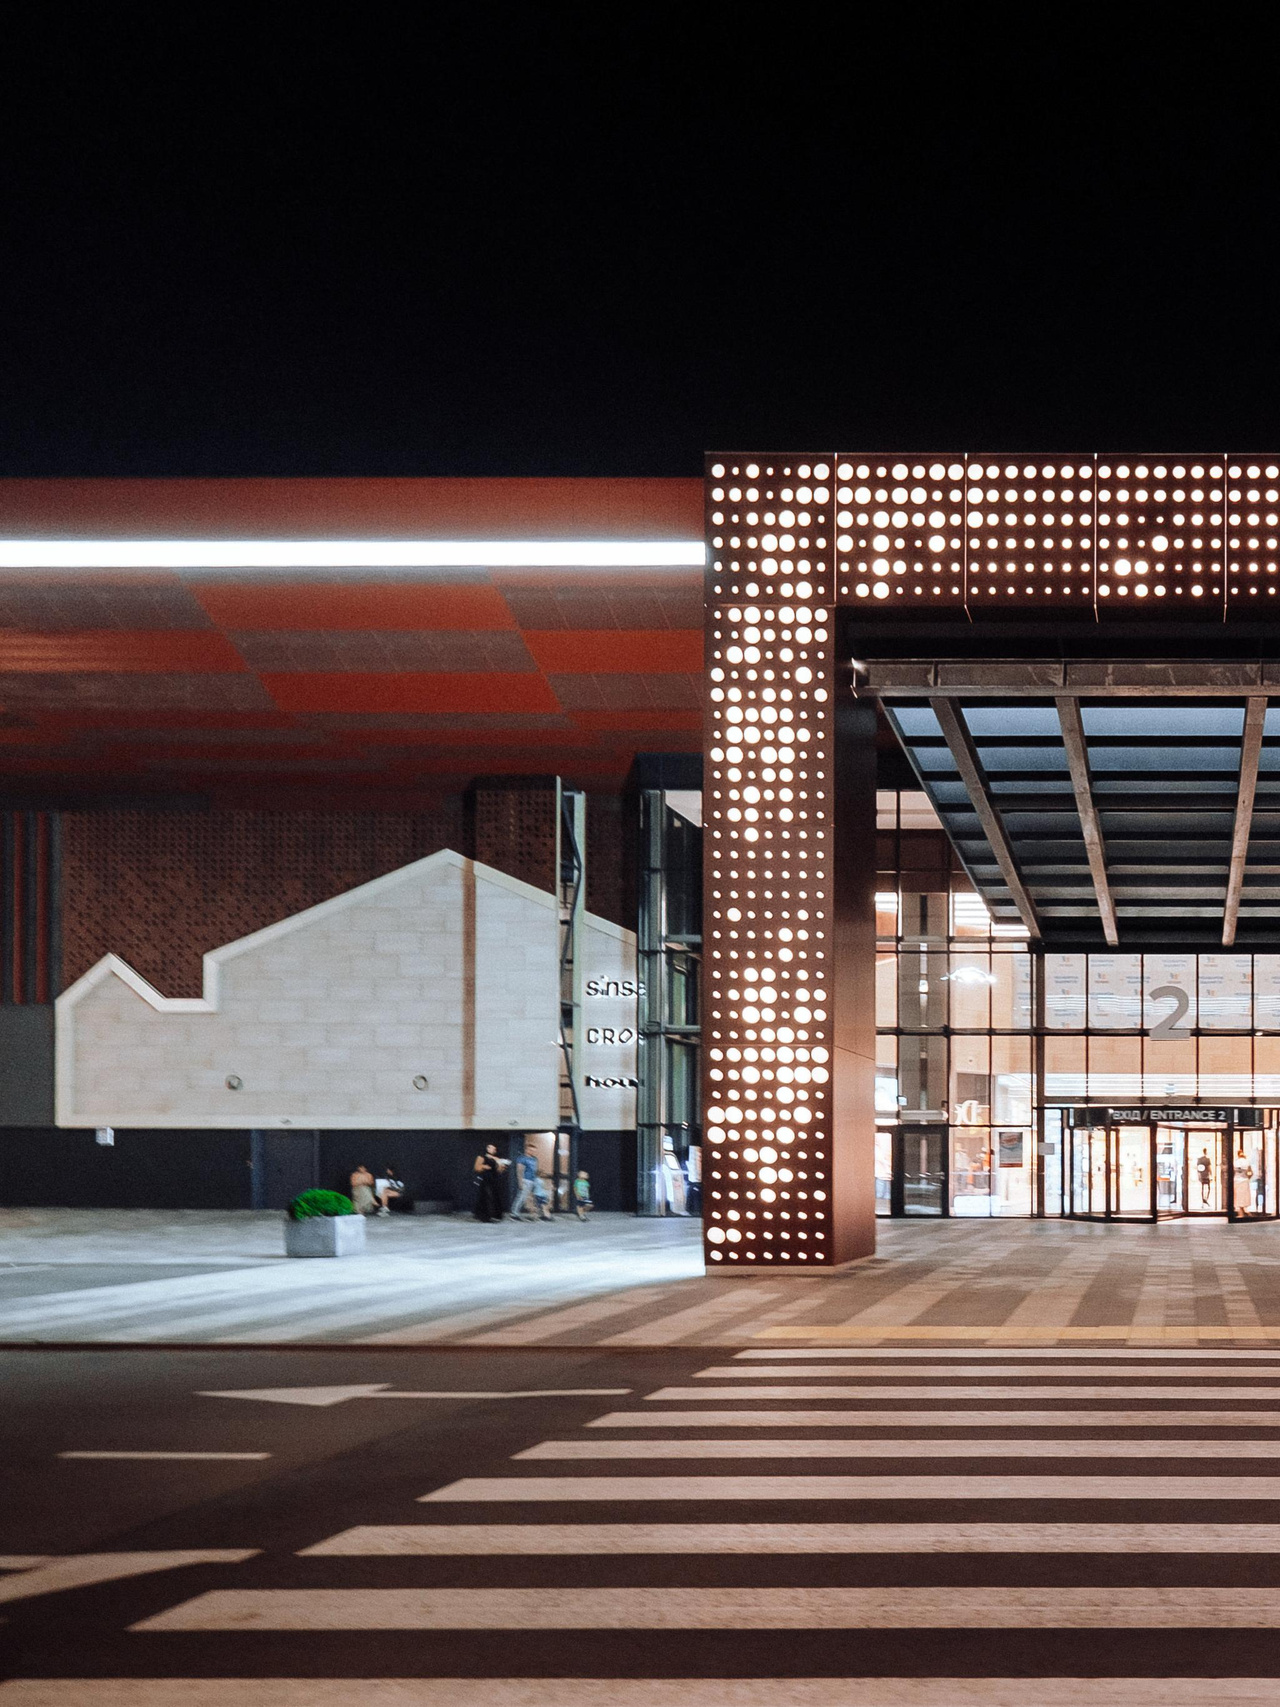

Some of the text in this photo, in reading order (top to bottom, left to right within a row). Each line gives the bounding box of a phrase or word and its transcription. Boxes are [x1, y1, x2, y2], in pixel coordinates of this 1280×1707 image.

[1148, 985, 1191, 1041] 2
[1150, 1110, 1216, 1120] ENTRANCE
[1218, 1110, 1226, 1120] 2
